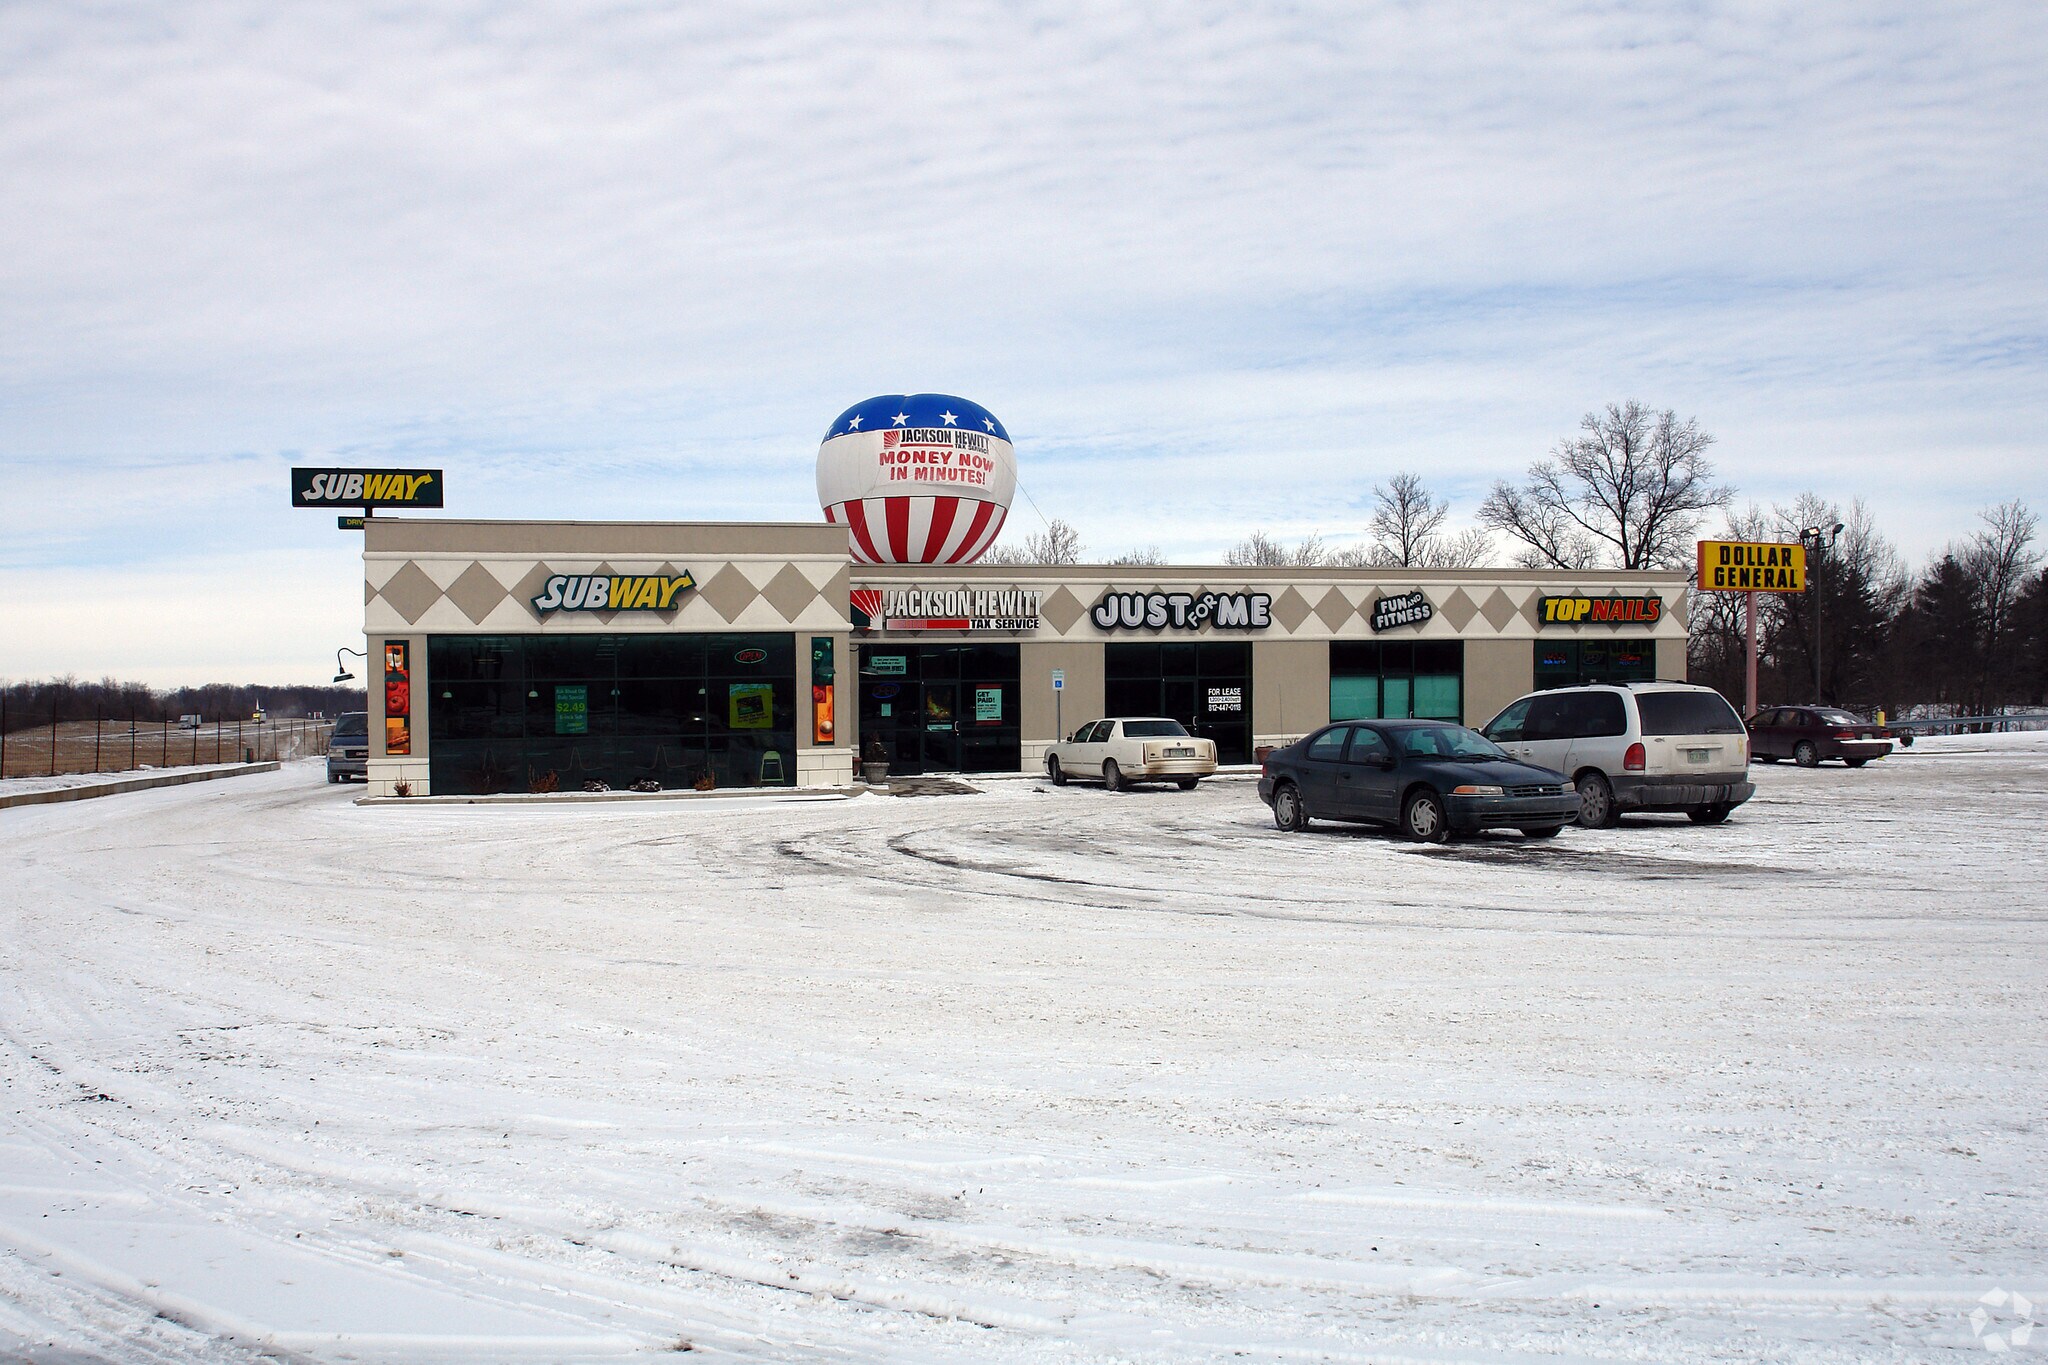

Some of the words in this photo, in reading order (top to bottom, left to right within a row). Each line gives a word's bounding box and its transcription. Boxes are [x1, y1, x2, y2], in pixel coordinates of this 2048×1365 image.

[901, 429, 952, 444] JACKSON
[955, 431, 990, 450] HEWITT
[880, 450, 953, 466] MONEY
[958, 453, 995, 473] NOW
[302, 473, 433, 501] SUBWAY
[890, 466, 908, 481] IN
[914, 466, 986, 486] MINUTES!
[1719, 545, 1792, 567] DOLLAR
[1714, 566, 1798, 588] GENERAL
[535, 575, 694, 611] SUBWAY
[886, 590, 970, 617] JACKSON
[975, 590, 1043, 617] HEWITT
[1380, 599, 1407, 615] FUN
[1407, 593, 1423, 609] AND
[1096, 595, 1192, 627] JUST
[1187, 594, 1218, 627] FOR
[1217, 595, 1269, 626] ME
[1376, 605, 1431, 628] FITNESS
[1545, 598, 1591, 622] TOP
[1591, 598, 1661, 622] NAILS
[971, 619, 991, 630] TAX
[995, 619, 1040, 630] SERVICE
[1208, 688, 1221, 696] FOR
[1222, 687, 1242, 696] LEASE
[556, 702, 585, 713] $2.49
